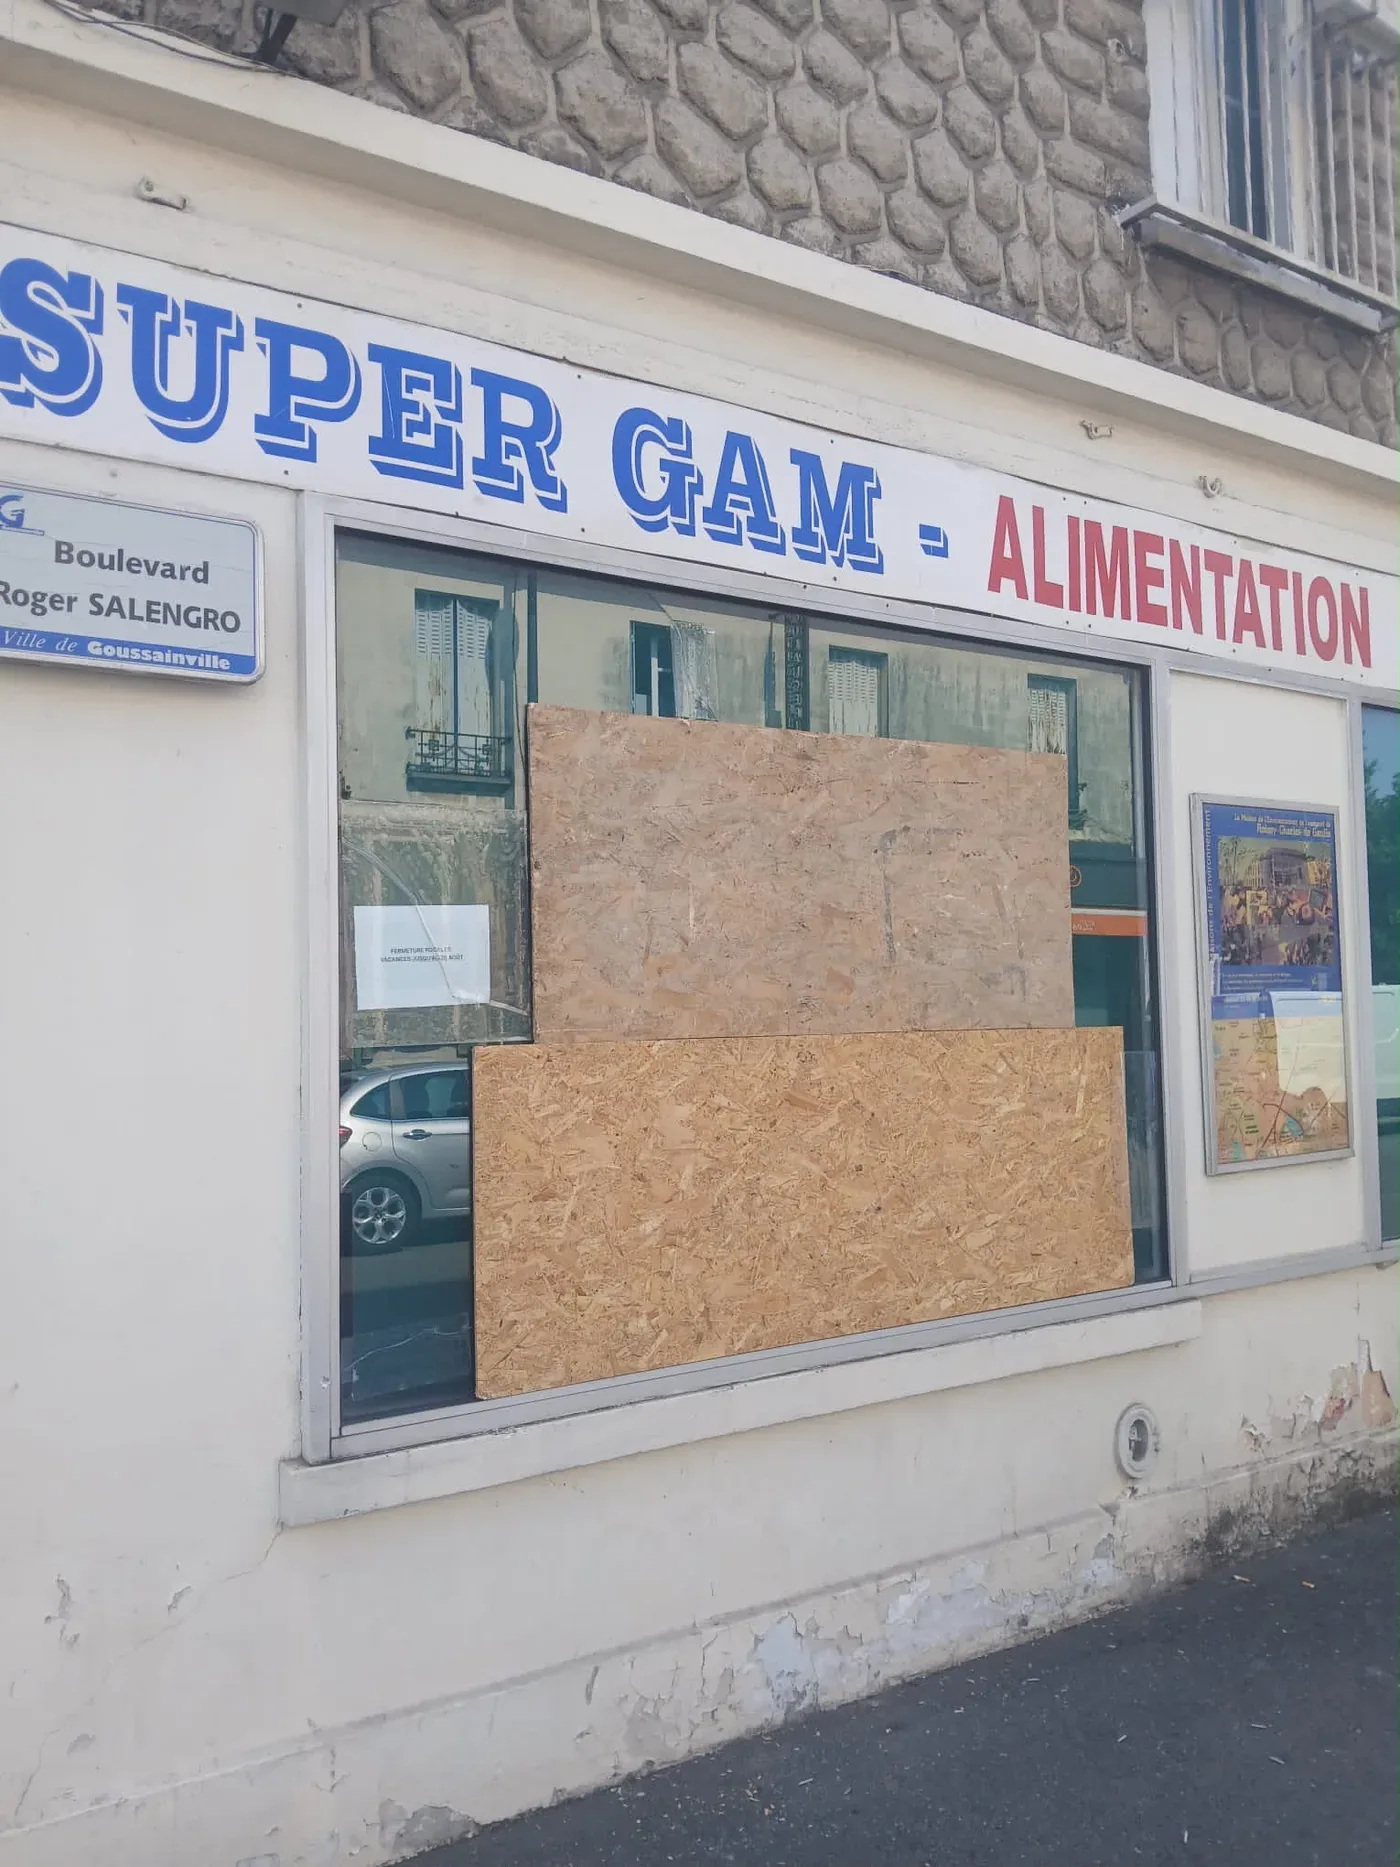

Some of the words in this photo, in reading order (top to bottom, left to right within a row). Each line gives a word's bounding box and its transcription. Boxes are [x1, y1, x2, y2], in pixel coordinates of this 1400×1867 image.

[0, 257, 568, 513] SUPER
[612, 406, 884, 575] GAM
[987, 494, 1373, 669] ALIMENTATION
[54, 540, 210, 584] Boulevard
[0, 580, 78, 617] Roger
[88, 592, 241, 633] SALENGRO
[3, 630, 47, 649] Ville
[55, 637, 78, 652] de
[87, 640, 231, 670] Goussainville
